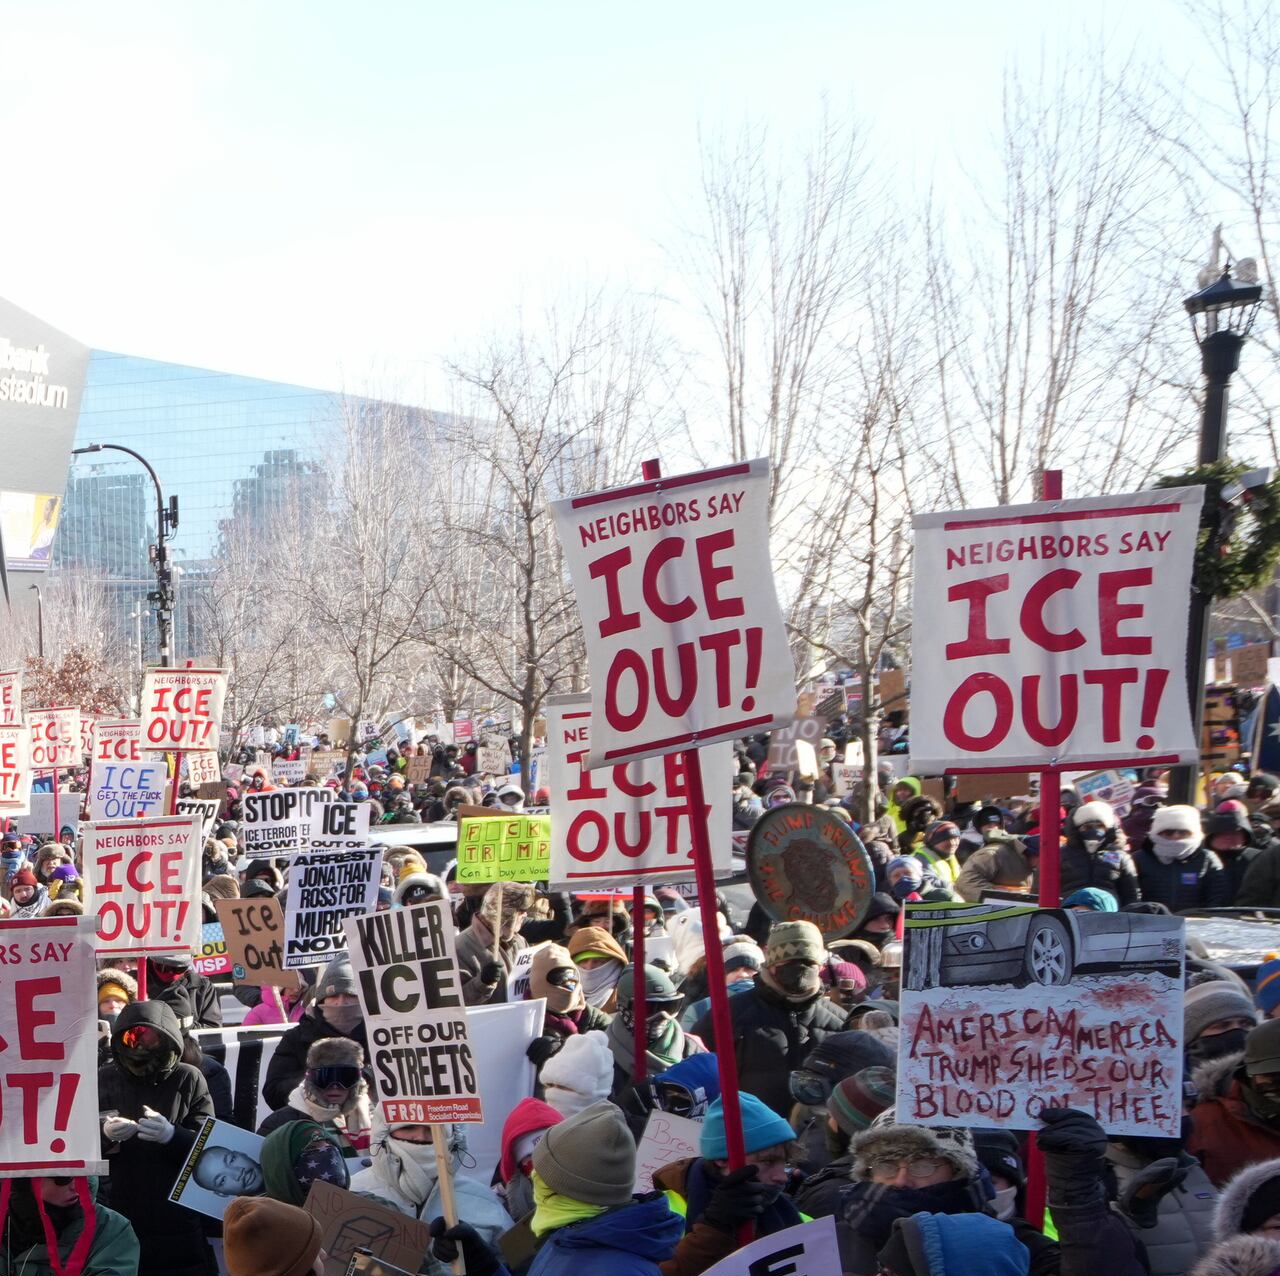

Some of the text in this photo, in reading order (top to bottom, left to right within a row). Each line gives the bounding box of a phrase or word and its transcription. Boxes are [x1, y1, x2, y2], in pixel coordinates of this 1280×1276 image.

[579, 490, 746, 547] NEIGHBORS SAY
[946, 530, 1171, 570] NEIGHBORS SAY
[154, 677, 200, 685] NEIGHBORS
[604, 626, 764, 733] OUT!
[943, 667, 1170, 752] OUT!
[31, 722, 71, 742] ICE
[147, 717, 214, 745] OUT!
[192, 759, 214, 769] ICE
[97, 790, 162, 800] GET THE FUCK
[245, 792, 297, 823] STOP
[105, 799, 155, 818] OUT
[96, 833, 190, 850] NEIGHBORS SAY
[246, 839, 298, 851] NOW!
[261, 825, 297, 841] TERROR
[311, 840, 343, 848] OUT
[293, 851, 380, 866] ARREST
[298, 862, 373, 888] JONATHAN
[460, 867, 516, 879] Can buy
[300, 884, 367, 909] ROSS FOR
[96, 900, 190, 942] OUT!
[232, 905, 278, 935] Ice
[356, 904, 447, 968] KILLER
[29, 940, 73, 964] SAY
[244, 939, 284, 971] Out
[359, 958, 461, 1016] ICE
[373, 1021, 467, 1047] OFF OUR
[375, 1043, 476, 1097] STREETS
[921, 1046, 1168, 1088] TRUMP SHEDS OUR
[914, 1084, 1016, 1119] BLOOD
[428, 1112, 452, 1120] Socialist
